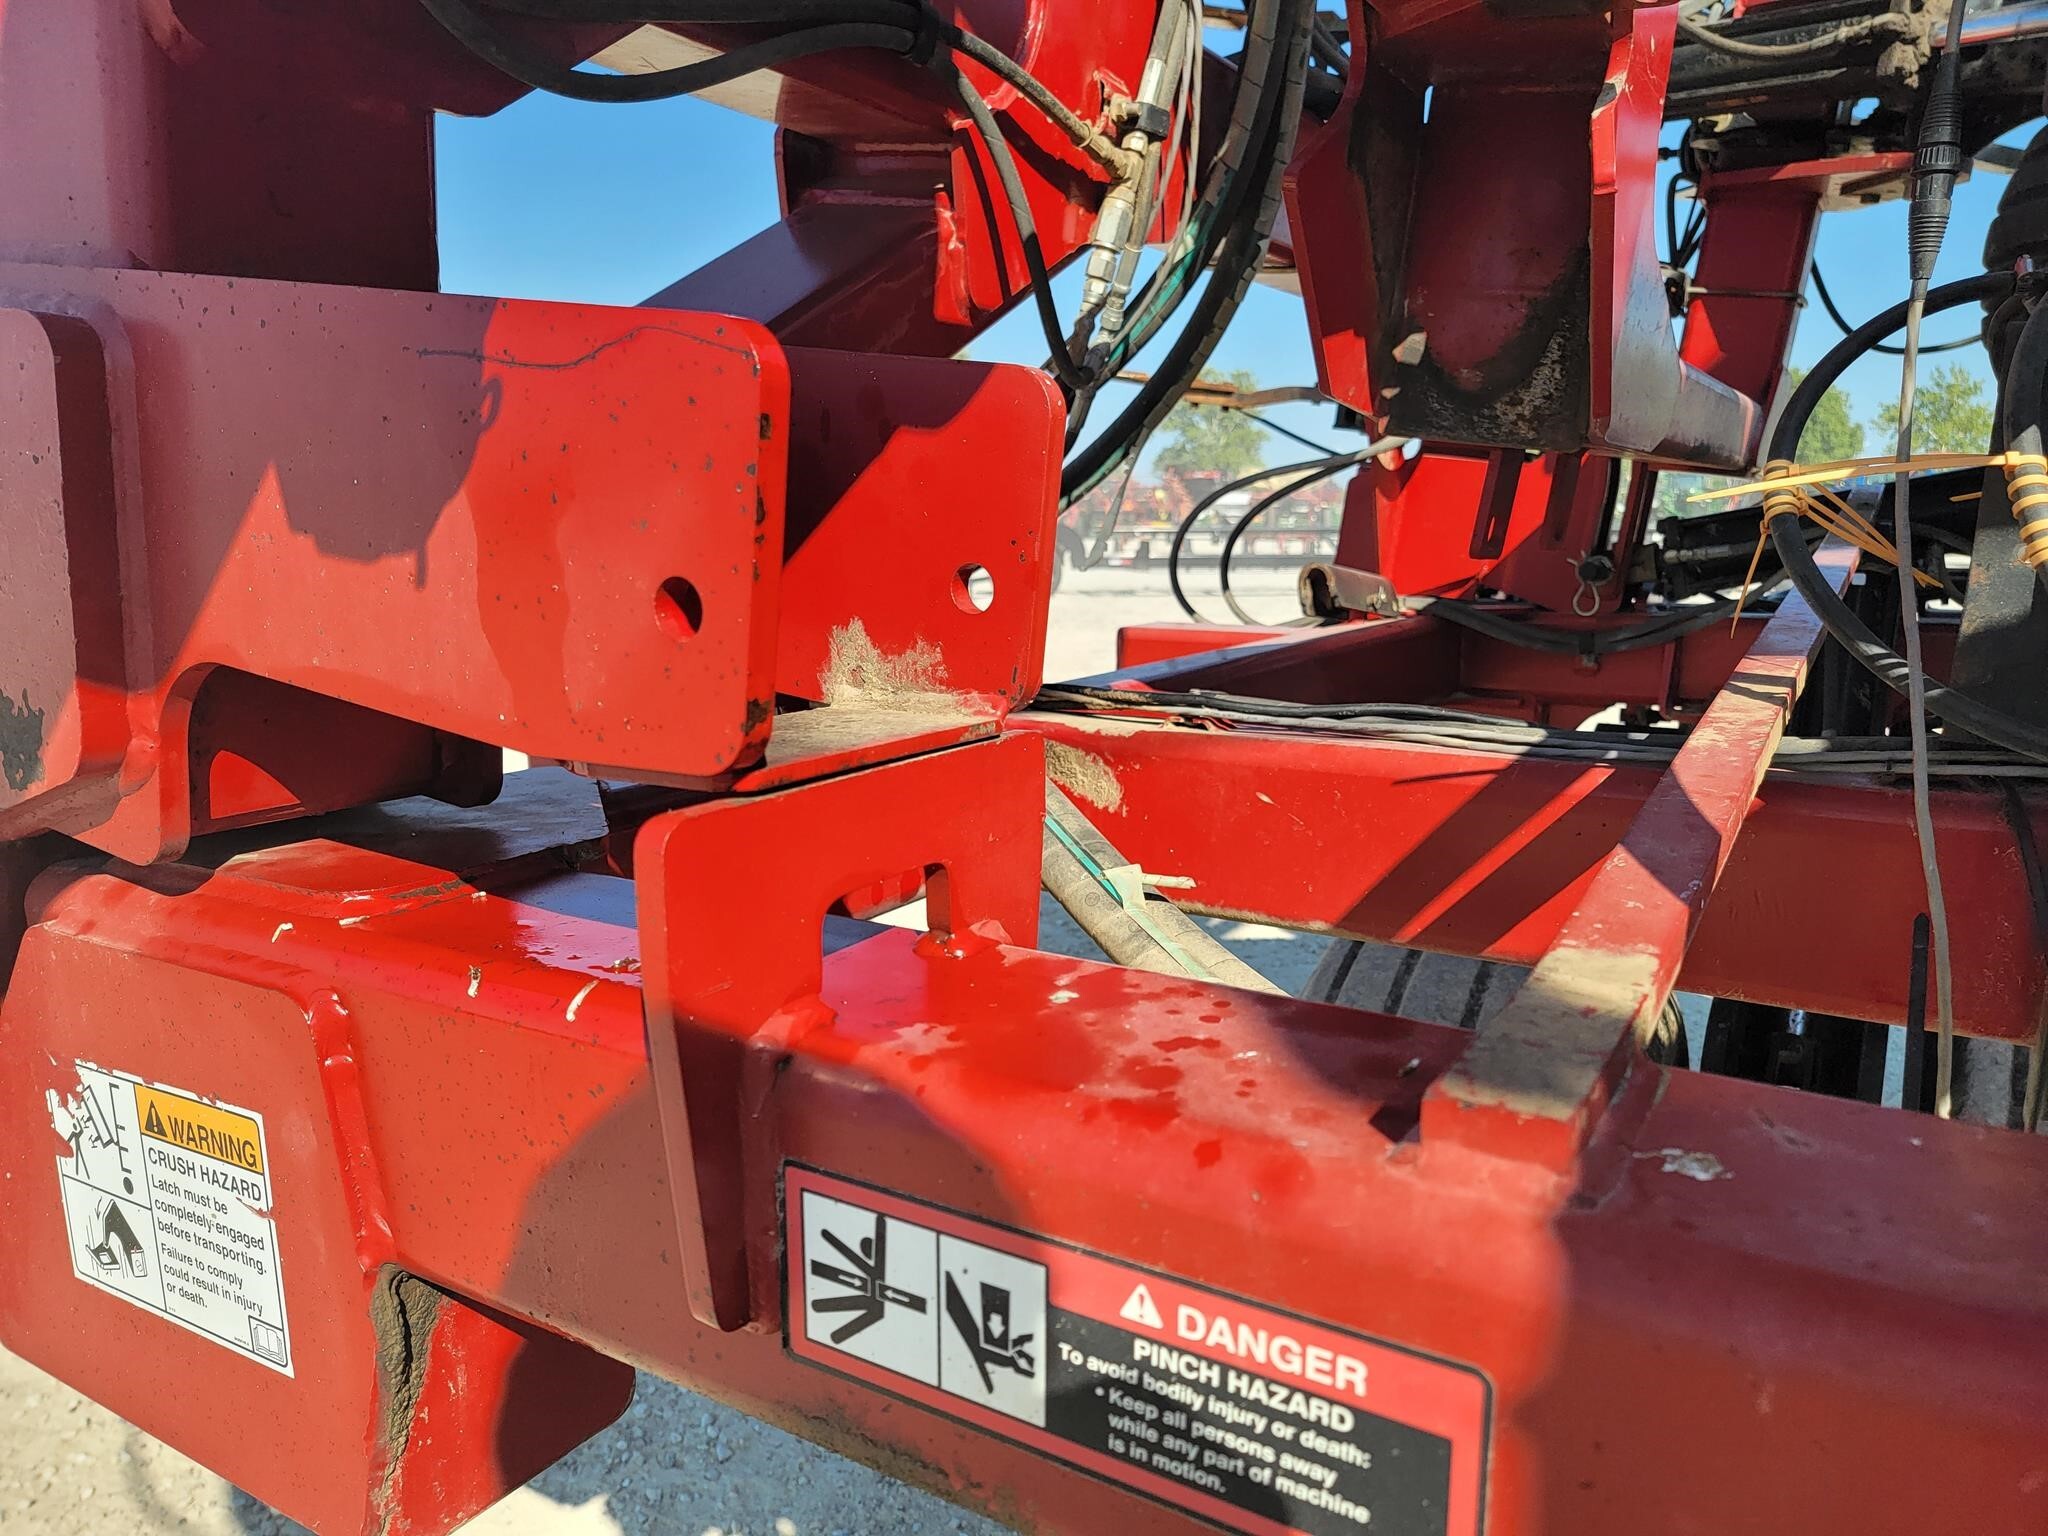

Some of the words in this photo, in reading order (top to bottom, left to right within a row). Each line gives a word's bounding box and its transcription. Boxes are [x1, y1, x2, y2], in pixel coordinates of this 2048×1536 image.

[168, 1115, 257, 1169] WARNING
[148, 1147, 196, 1179] CRUSH
[200, 1165, 261, 1201] HAZARD
[152, 1174, 181, 1197] Latch
[184, 1188, 211, 1209] must
[213, 1197, 228, 1215] be
[155, 1199, 212, 1233] completely
[216, 1222, 264, 1250] engaged
[157, 1217, 191, 1242] before
[193, 1232, 267, 1275] transporting.
[161, 1243, 193, 1266] Failure
[195, 1258, 205, 1271] to
[207, 1264, 243, 1290] comply
[164, 1264, 189, 1282] could
[192, 1275, 219, 1295] result
[222, 1286, 231, 1300] in
[234, 1291, 262, 1317] injury
[166, 1282, 175, 1293] or
[179, 1286, 207, 1308] death.
[1177, 1303, 1369, 1398] DANGER
[1058, 1341, 1084, 1365] To
[1086, 1356, 1139, 1385] avoid
[1142, 1371, 1205, 1412] bodily
[1207, 1394, 1268, 1434] injury
[1271, 1421, 1297, 1441] or
[1299, 1429, 1372, 1470] death:
[1133, 1337, 1221, 1388] PINCH
[1227, 1369, 1355, 1433] HAZARD
[1108, 1387, 1159, 1421] Keep
[1162, 1410, 1187, 1430] all
[1191, 1421, 1276, 1464] persons
[1278, 1452, 1339, 1489] away
[1108, 1433, 1126, 1453] is
[1129, 1441, 1148, 1462] in
[1152, 1453, 1226, 1493] motion.
[1108, 1413, 1159, 1443] while
[1162, 1434, 1199, 1461] any
[1203, 1449, 1245, 1477] part
[1248, 1466, 1273, 1486] of
[1275, 1475, 1371, 1524] machine
